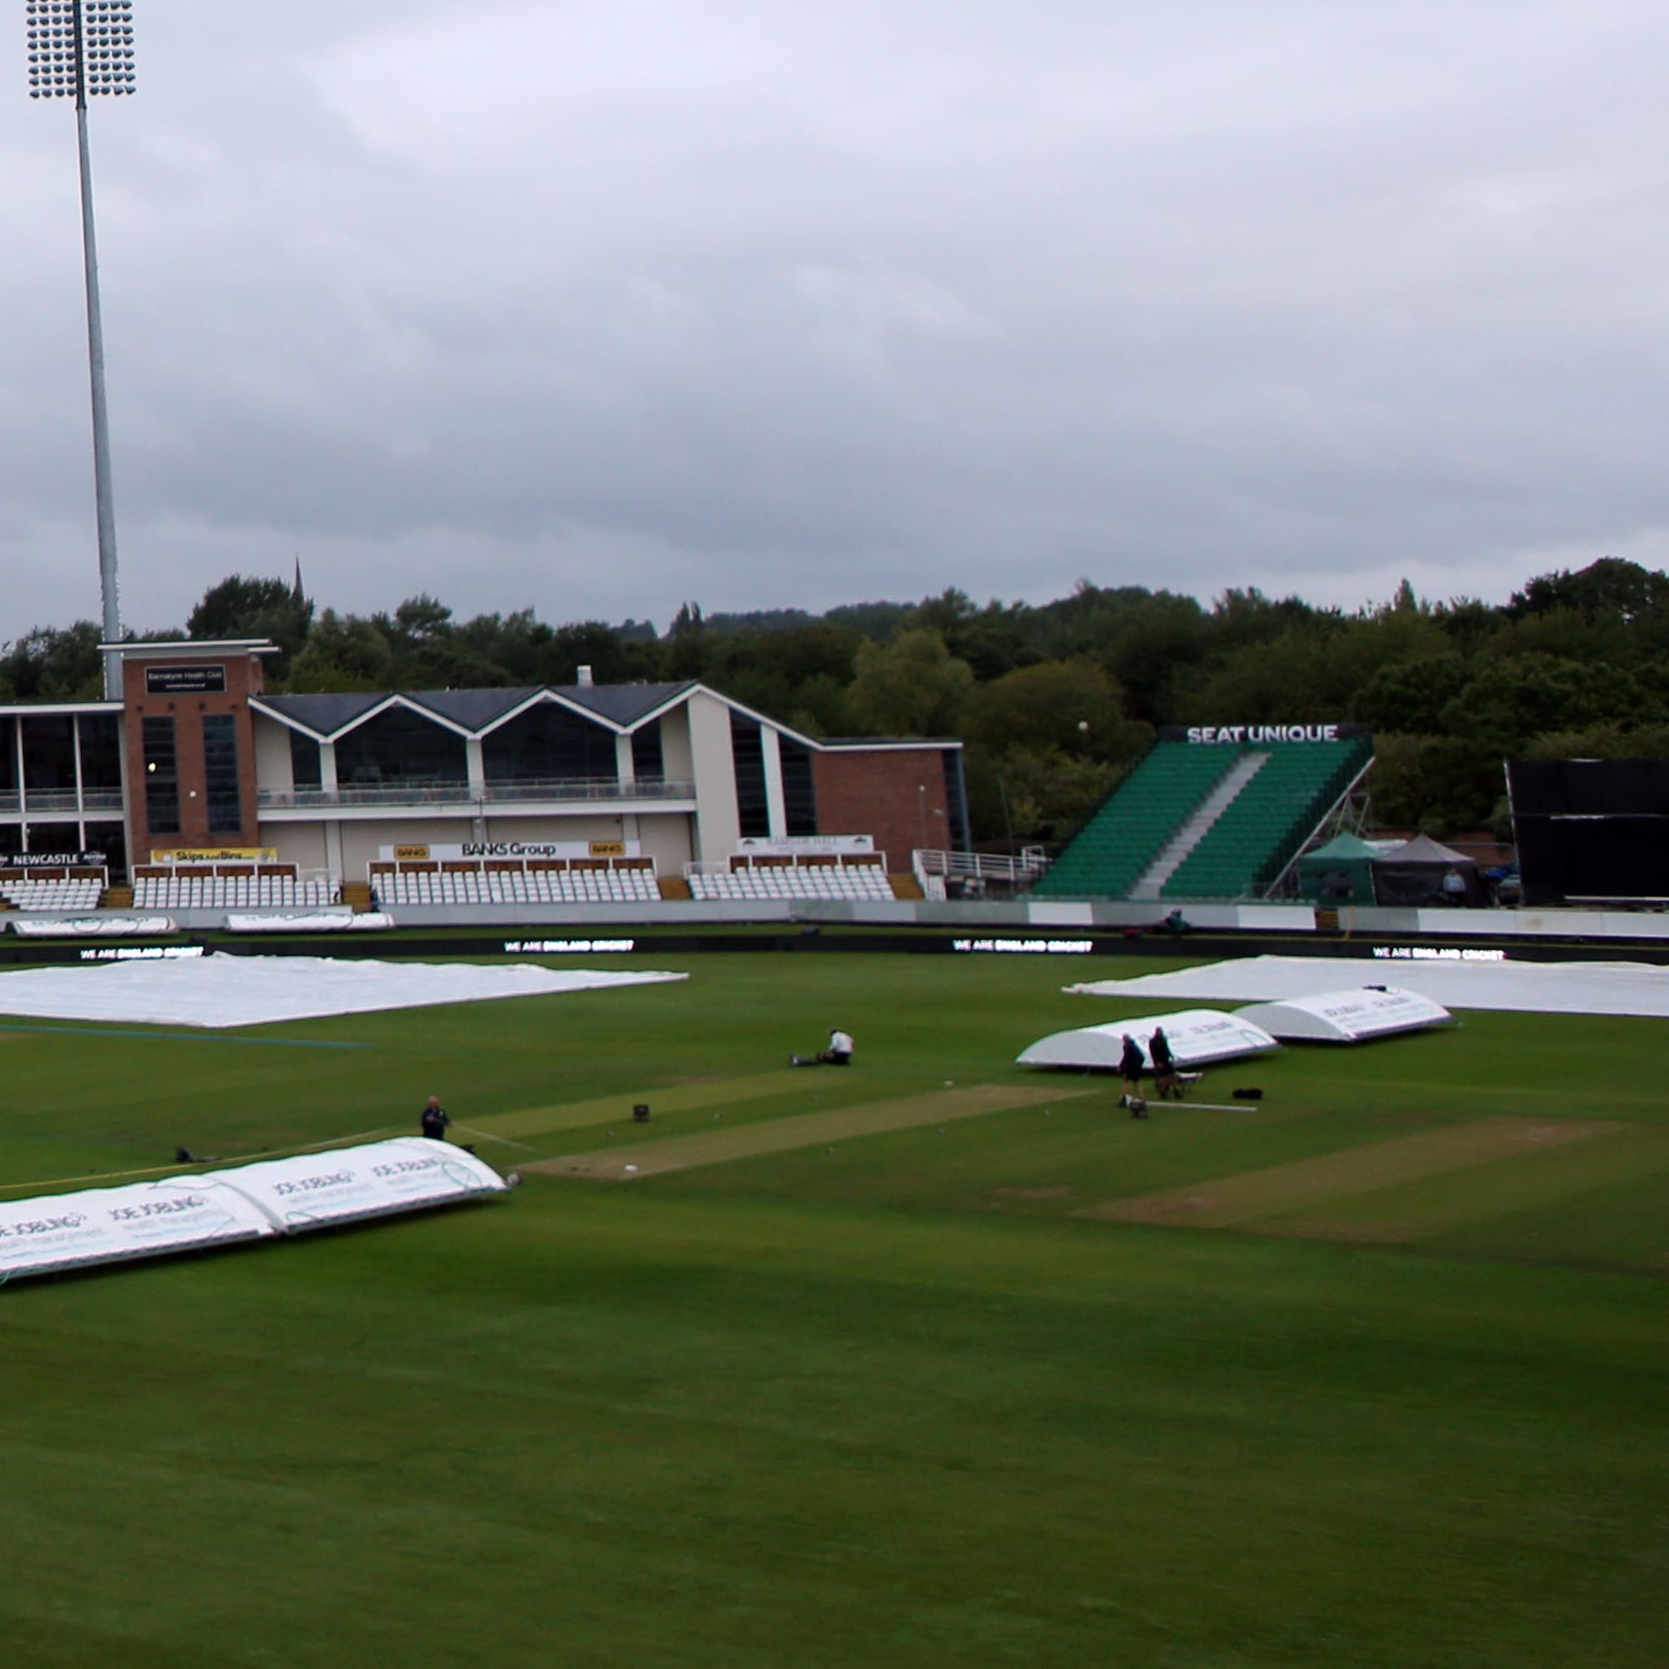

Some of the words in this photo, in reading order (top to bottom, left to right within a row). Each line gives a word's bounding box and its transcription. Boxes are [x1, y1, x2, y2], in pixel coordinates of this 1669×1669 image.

[1187, 727, 1244, 744] SEAT
[1249, 725, 1338, 742] UNIQUE
[462, 843, 508, 856] BANKS
[510, 842, 556, 857] Group
[13, 854, 78, 865] NEWCASTLE
[141, 1196, 204, 1218] JOBLING
[12, 1215, 81, 1236] JOBLING
